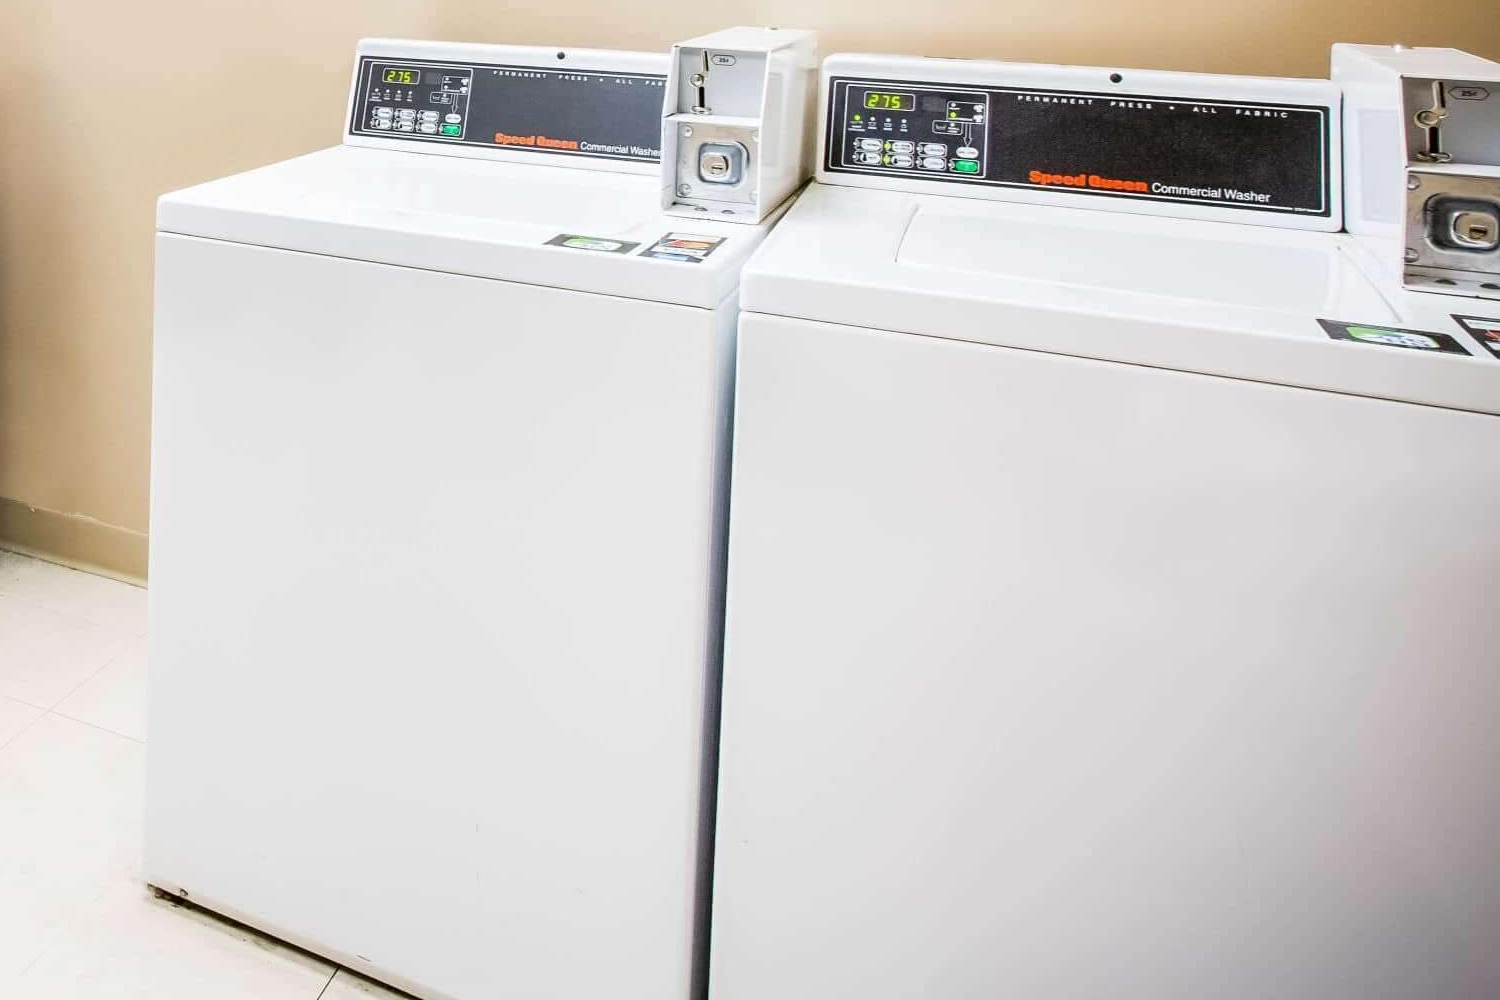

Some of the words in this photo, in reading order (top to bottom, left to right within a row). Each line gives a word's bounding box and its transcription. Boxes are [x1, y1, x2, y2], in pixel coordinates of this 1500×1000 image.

[386, 70, 412, 83] 275
[492, 70, 547, 79] PERMANENT
[558, 74, 588, 82] PRESS
[866, 93, 902, 109] 275
[1017, 95, 1093, 105] PERMANENT
[1110, 101, 1153, 110] PRESS
[1192, 105, 1218, 114] ALL
[1235, 108, 1289, 119] FABRIC
[494, 131, 535, 146] Speed
[579, 140, 629, 154] Commercial
[1028, 169, 1086, 187] Speed
[1087, 174, 1149, 193] Queen
[1151, 182, 1222, 199] Commercial
[1223, 188, 1271, 203] Washer
